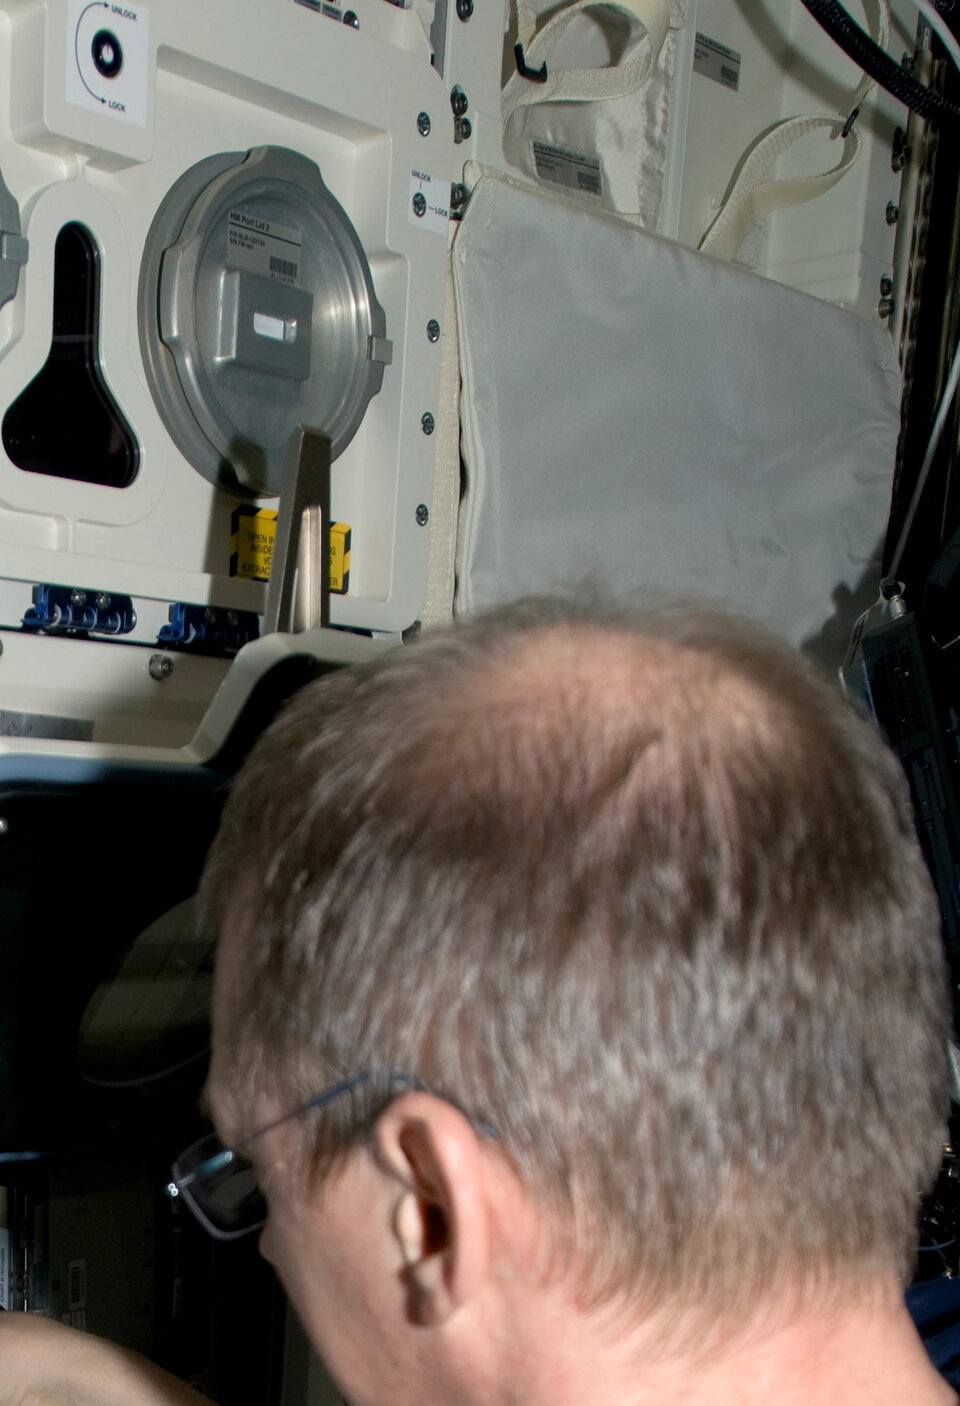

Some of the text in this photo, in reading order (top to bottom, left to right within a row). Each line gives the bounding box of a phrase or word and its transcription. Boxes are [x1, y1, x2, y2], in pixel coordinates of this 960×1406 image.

[111, 4, 138, 21] UNLOCK
[108, 100, 126, 112] LOCK
[411, 169, 432, 183] UNLOCK
[435, 206, 449, 217] LOCK
[230, 211, 240, 221] HM
[241, 215, 254, 226] Port
[255, 220, 265, 230] Lid
[247, 532, 268, 544] OPEN
